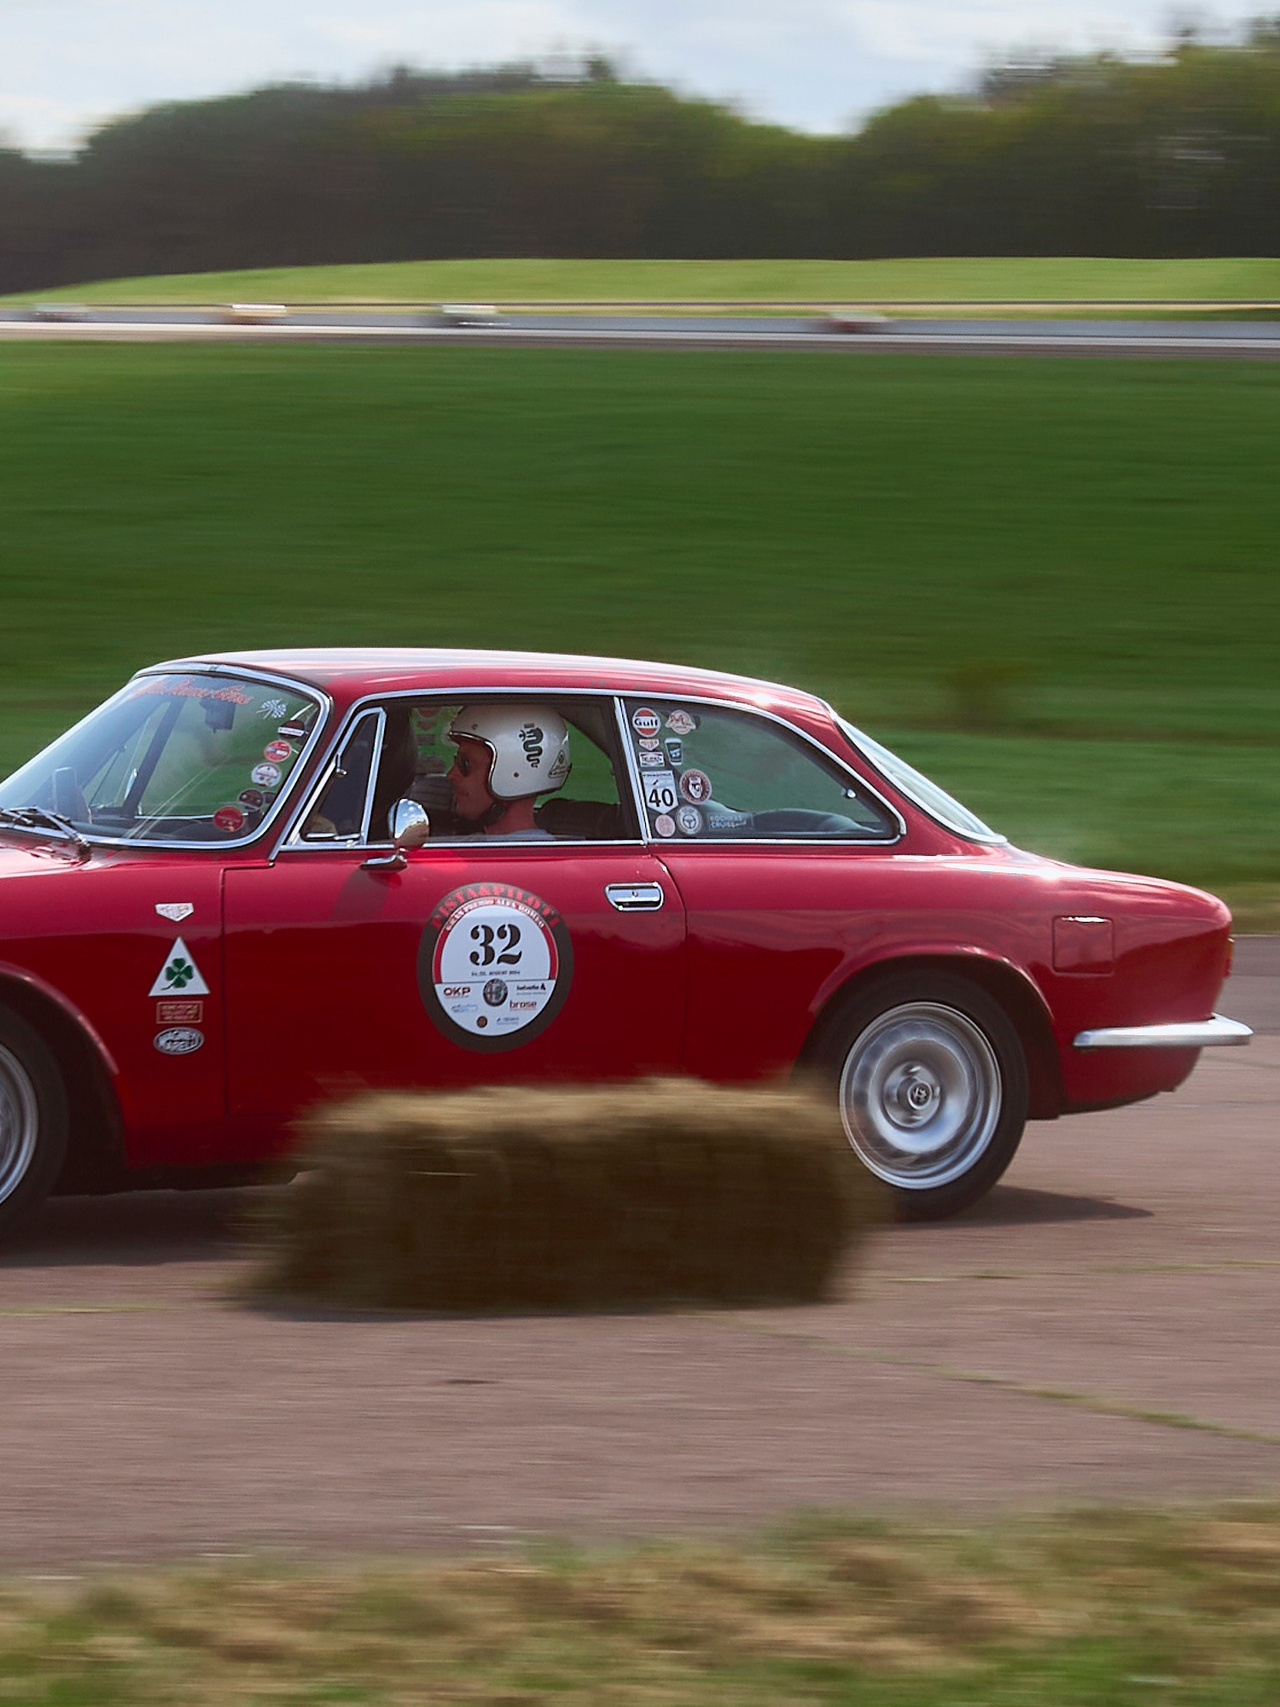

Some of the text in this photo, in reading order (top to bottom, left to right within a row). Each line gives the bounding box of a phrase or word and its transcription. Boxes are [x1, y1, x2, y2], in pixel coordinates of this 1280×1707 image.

[634, 718, 658, 727] Gulf
[648, 788, 674, 807] 40
[470, 924, 523, 966] 32
[443, 986, 471, 996] OKP
[509, 1000, 538, 1009] brose
